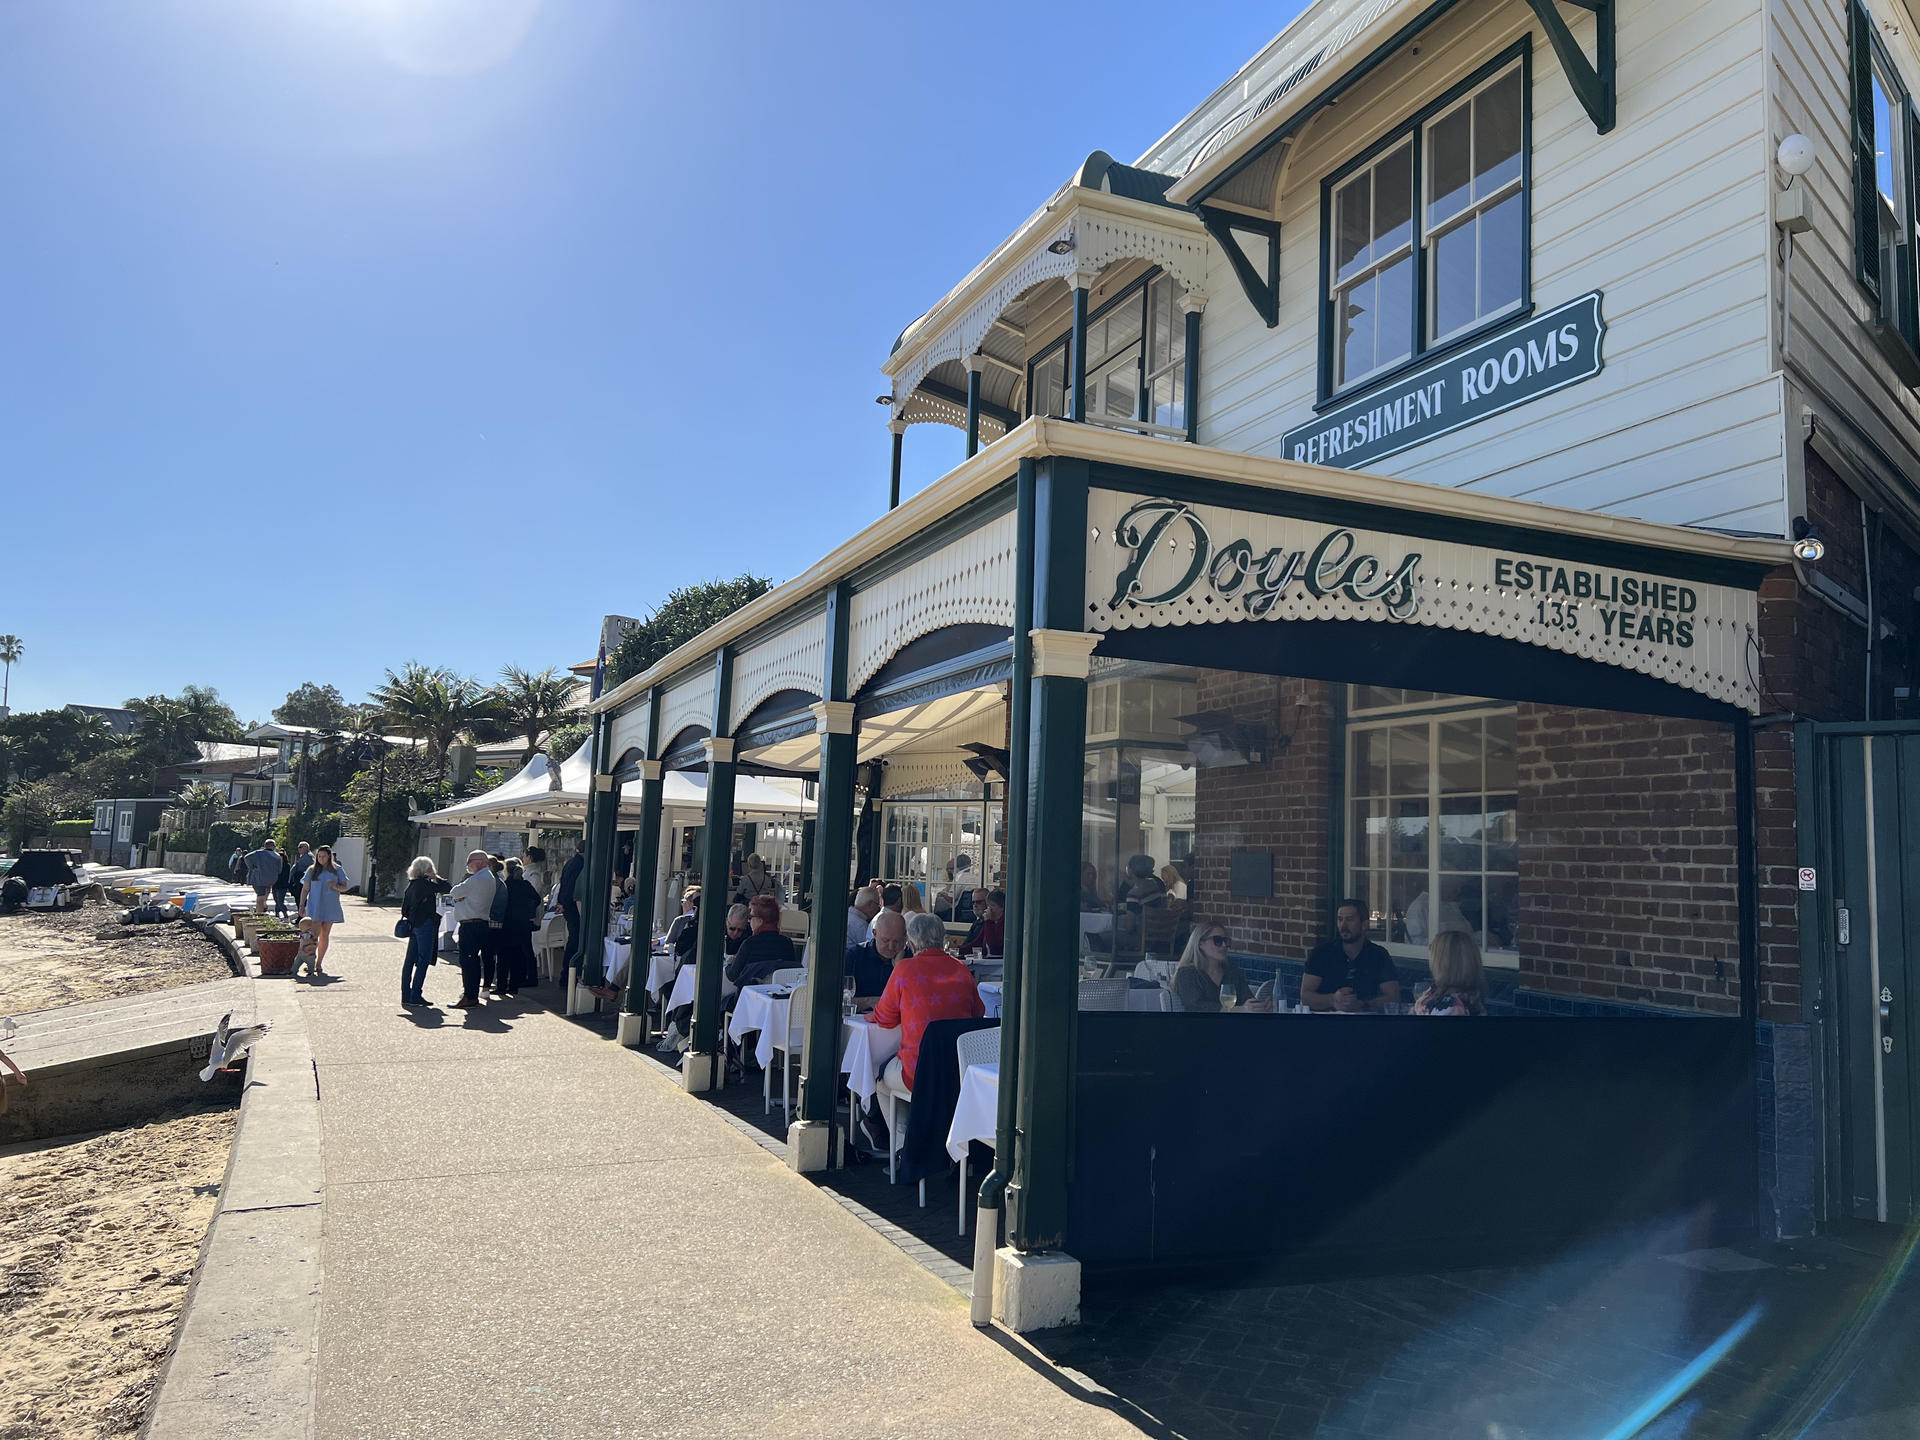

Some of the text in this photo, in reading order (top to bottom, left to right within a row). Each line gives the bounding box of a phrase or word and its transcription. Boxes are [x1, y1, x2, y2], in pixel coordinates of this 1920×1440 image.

[1294, 323, 1579, 464] REFRESHMENT ROOMS
[1108, 497, 1422, 620] Doyles
[1495, 558, 1697, 613] ESTABLISHED
[1537, 600, 1694, 648] 135 YEARS
